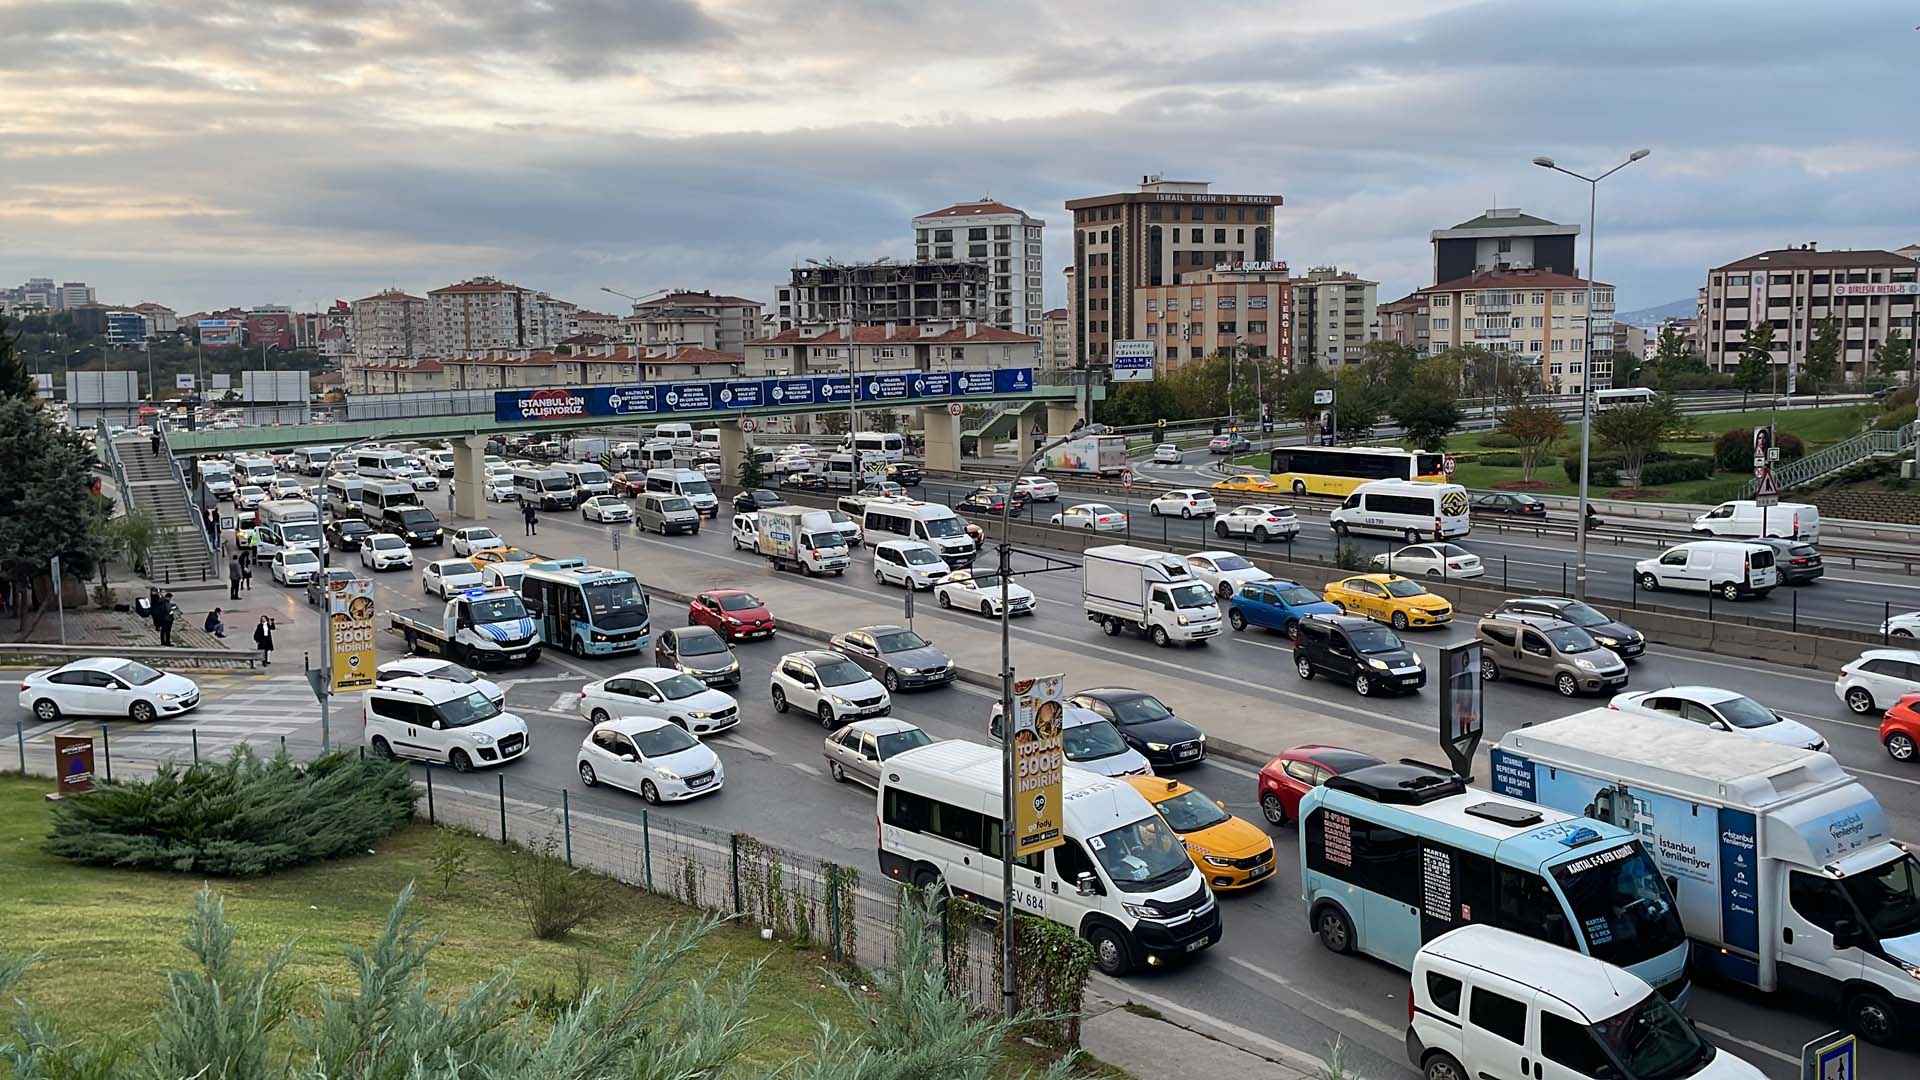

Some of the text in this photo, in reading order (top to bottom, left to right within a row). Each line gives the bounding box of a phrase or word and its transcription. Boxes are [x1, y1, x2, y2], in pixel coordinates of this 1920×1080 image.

[1157, 193, 1184, 201] İSMAİL
[1192, 194, 1216, 202] ERGİN
[1237, 195, 1271, 203] MERKEZİ
[518, 396, 585, 408] İSTANBUL İÇİN
[521, 405, 583, 418] ÇALIŞIYORUZ
[336, 643, 373, 653] İNDİRİM
[1018, 738, 1060, 756] TOPLAM
[1019, 773, 1060, 792] İNDİRİM
[1028, 820, 1052, 833] gofody
[1093, 838, 1102, 847] 2
[1659, 834, 1697, 856] İstanbul
[1566, 859, 1594, 875] KARTAL
[1590, 855, 1604, 867] E-5
[1659, 847, 1711, 869] Yenileniyor
[1026, 894, 1044, 911] 684
